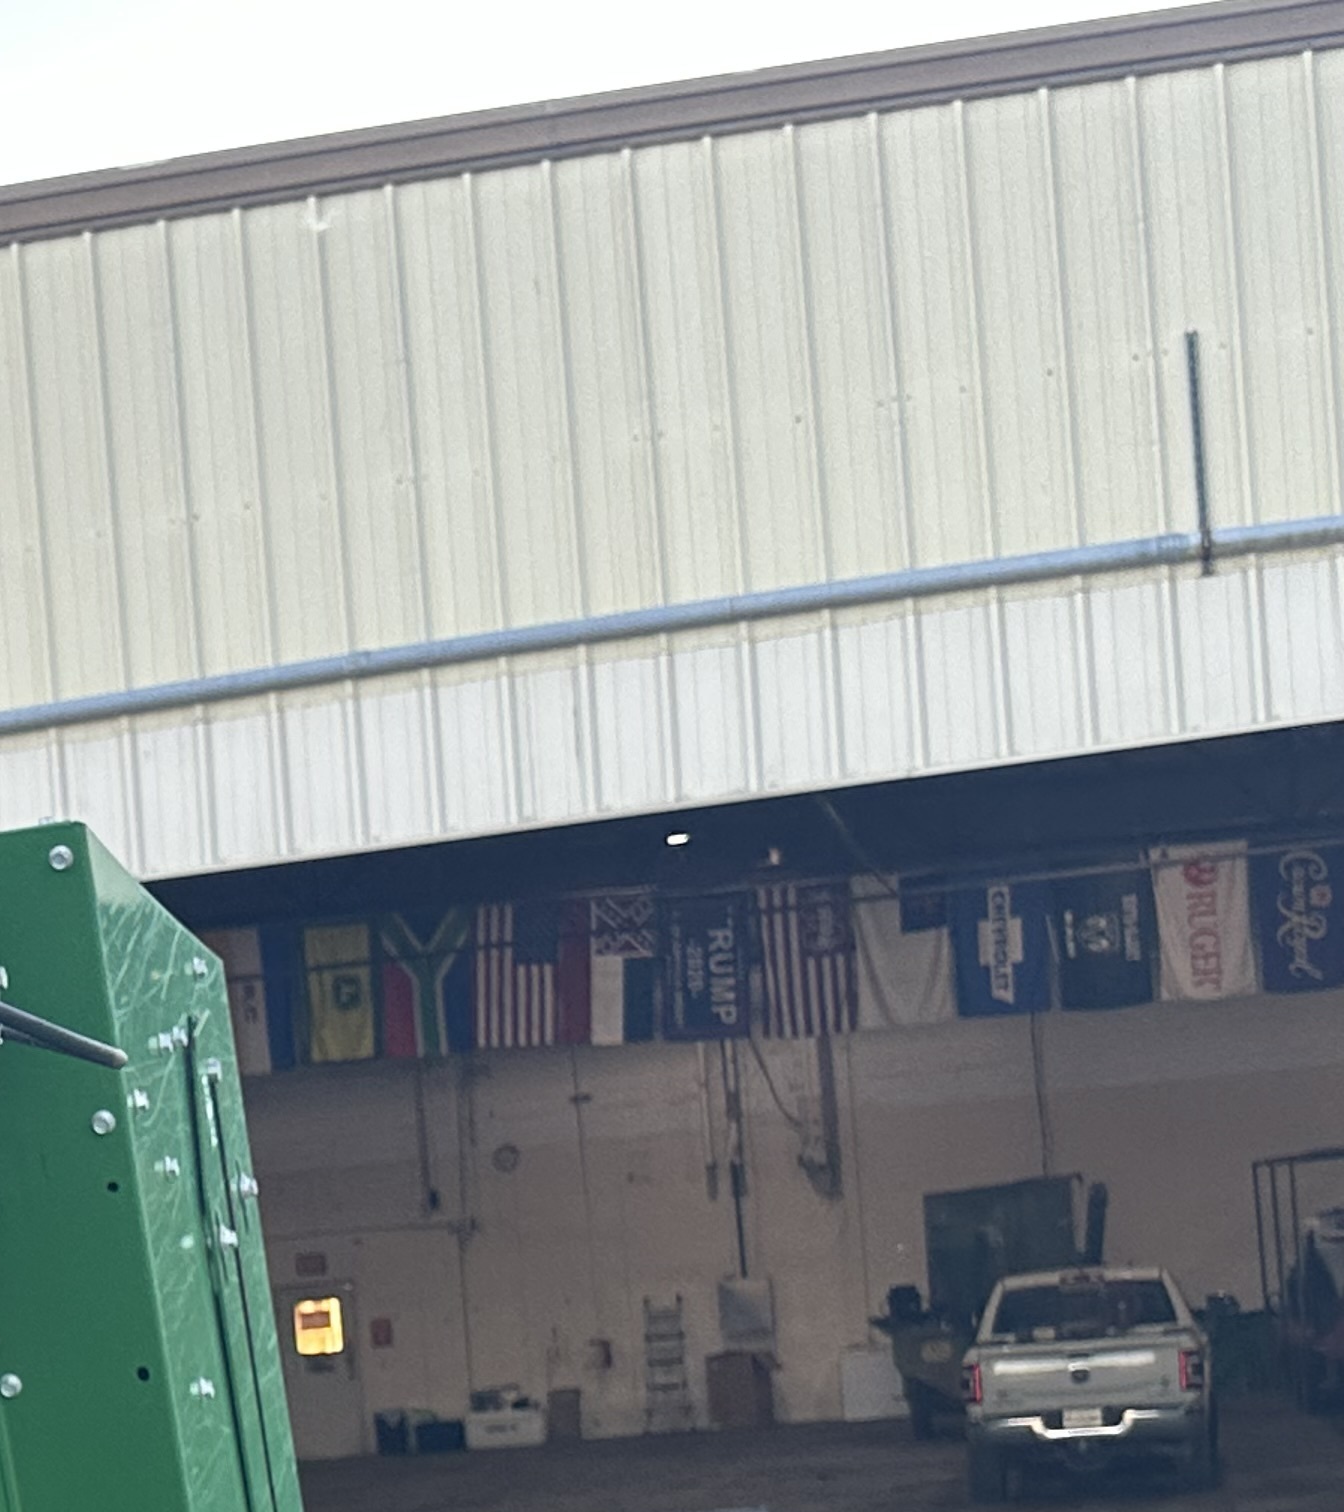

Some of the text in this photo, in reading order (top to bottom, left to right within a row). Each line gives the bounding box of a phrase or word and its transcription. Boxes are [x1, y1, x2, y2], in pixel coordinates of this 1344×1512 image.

[991, 890, 1008, 991] CHEVROLET
[1187, 890, 1223, 990] RUGER
[1277, 851, 1328, 980] Crown Royal
